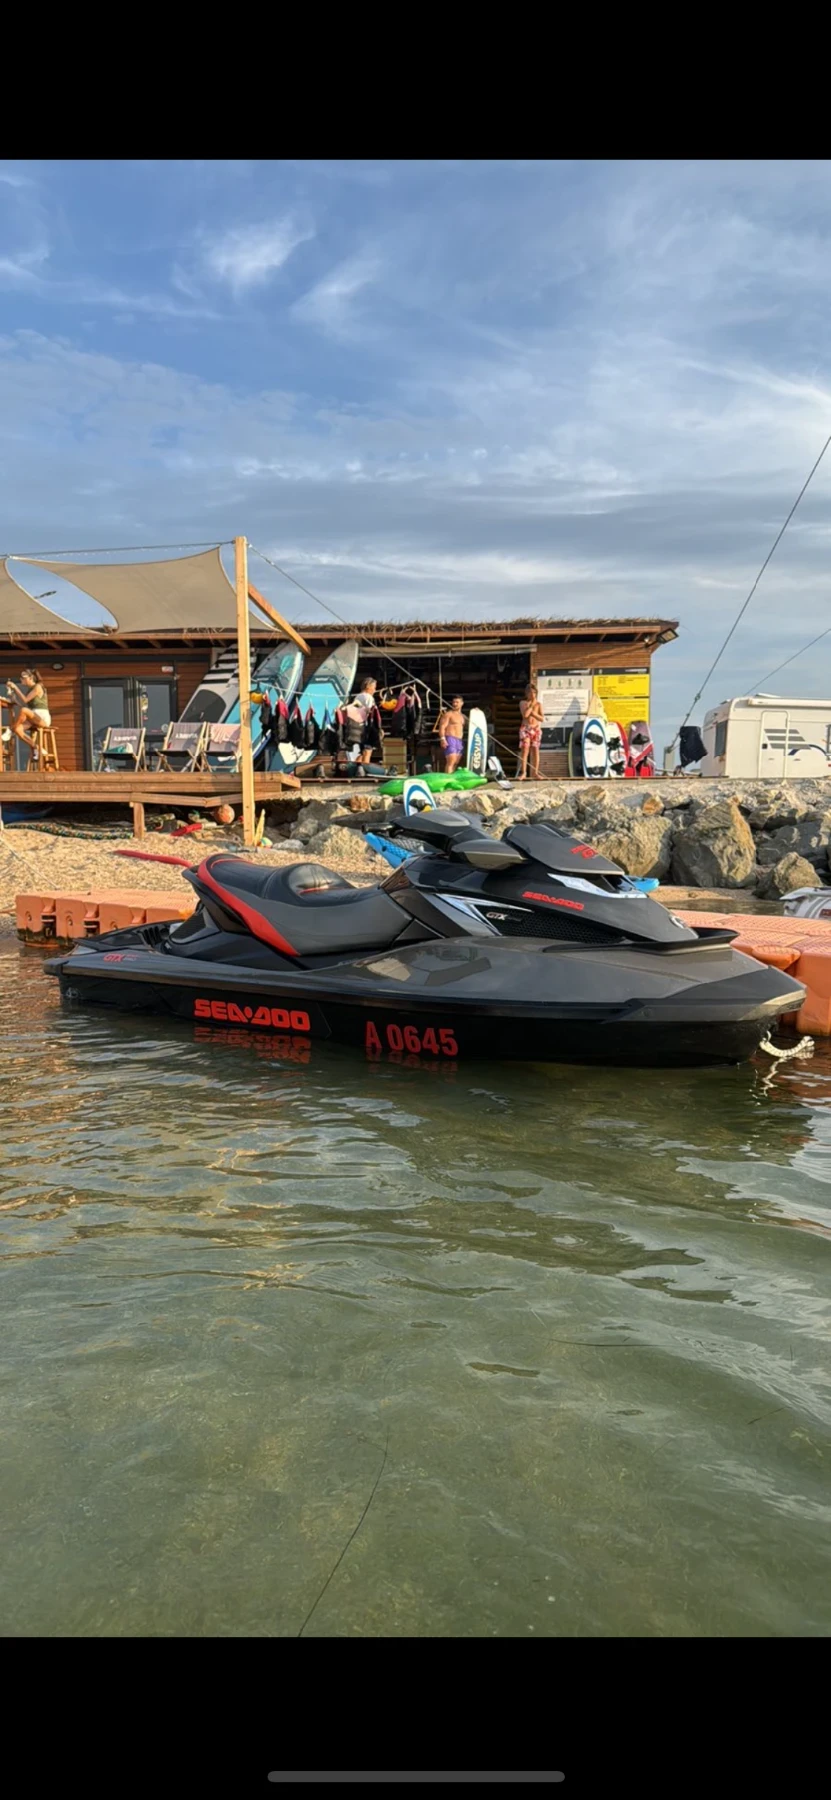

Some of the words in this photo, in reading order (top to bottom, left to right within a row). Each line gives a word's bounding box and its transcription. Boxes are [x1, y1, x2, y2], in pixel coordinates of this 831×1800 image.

[486, 911, 508, 921] GTX
[103, 953, 125, 963] GTX
[366, 1021, 383, 1049] A
[386, 1024, 459, 1057] 0645
